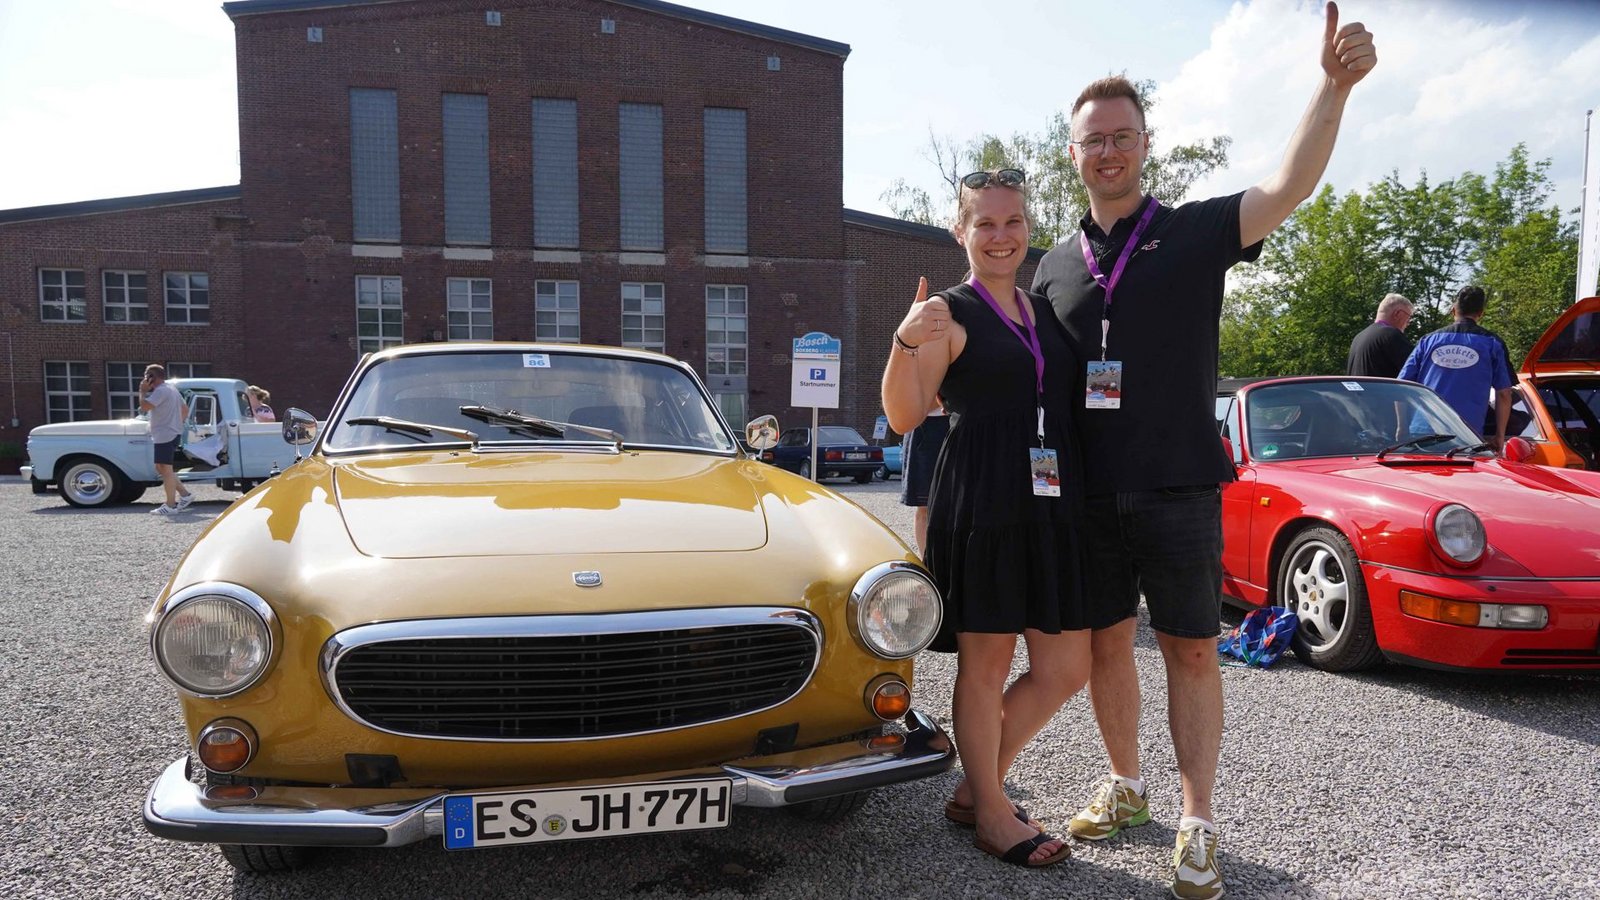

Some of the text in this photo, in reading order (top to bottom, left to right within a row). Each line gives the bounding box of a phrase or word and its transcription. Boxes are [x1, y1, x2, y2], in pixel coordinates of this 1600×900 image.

[796, 337, 828, 348] Bosch
[1435, 347, 1476, 359] Rockets
[814, 369, 822, 380] P
[476, 786, 728, 841] ES JH 77H
[455, 827, 465, 840] D
